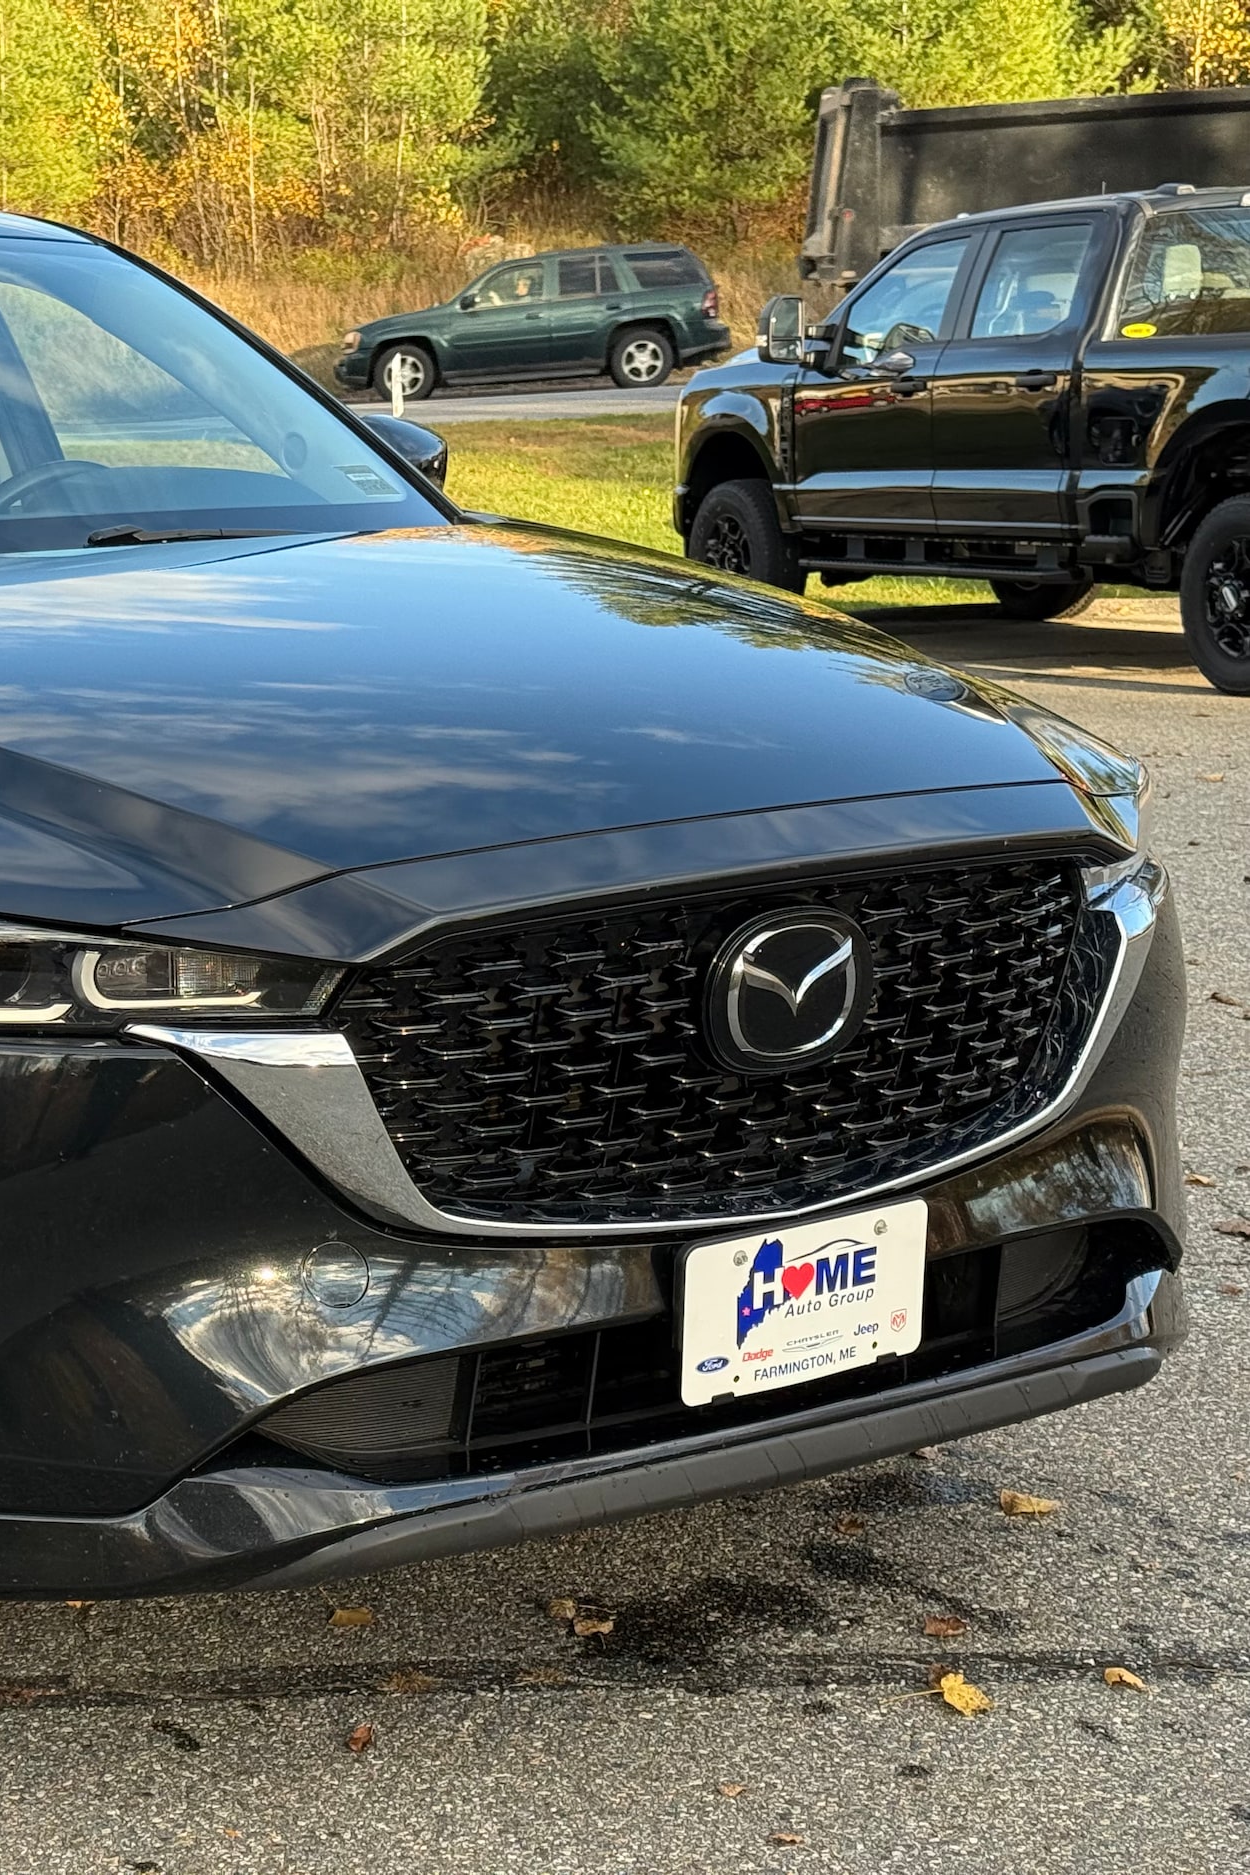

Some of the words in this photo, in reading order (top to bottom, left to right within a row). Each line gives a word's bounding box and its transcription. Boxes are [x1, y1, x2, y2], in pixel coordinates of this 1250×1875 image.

[784, 1297, 822, 1319] Auto
[828, 1287, 875, 1307] Group
[853, 1322, 879, 1337] Jeep
[785, 1329, 840, 1347] CHRYSLER
[741, 1348, 774, 1362] Dodge
[700, 1358, 725, 1372] Ford
[754, 1352, 837, 1382] FARMINGTON,
[839, 1346, 857, 1366] ME
